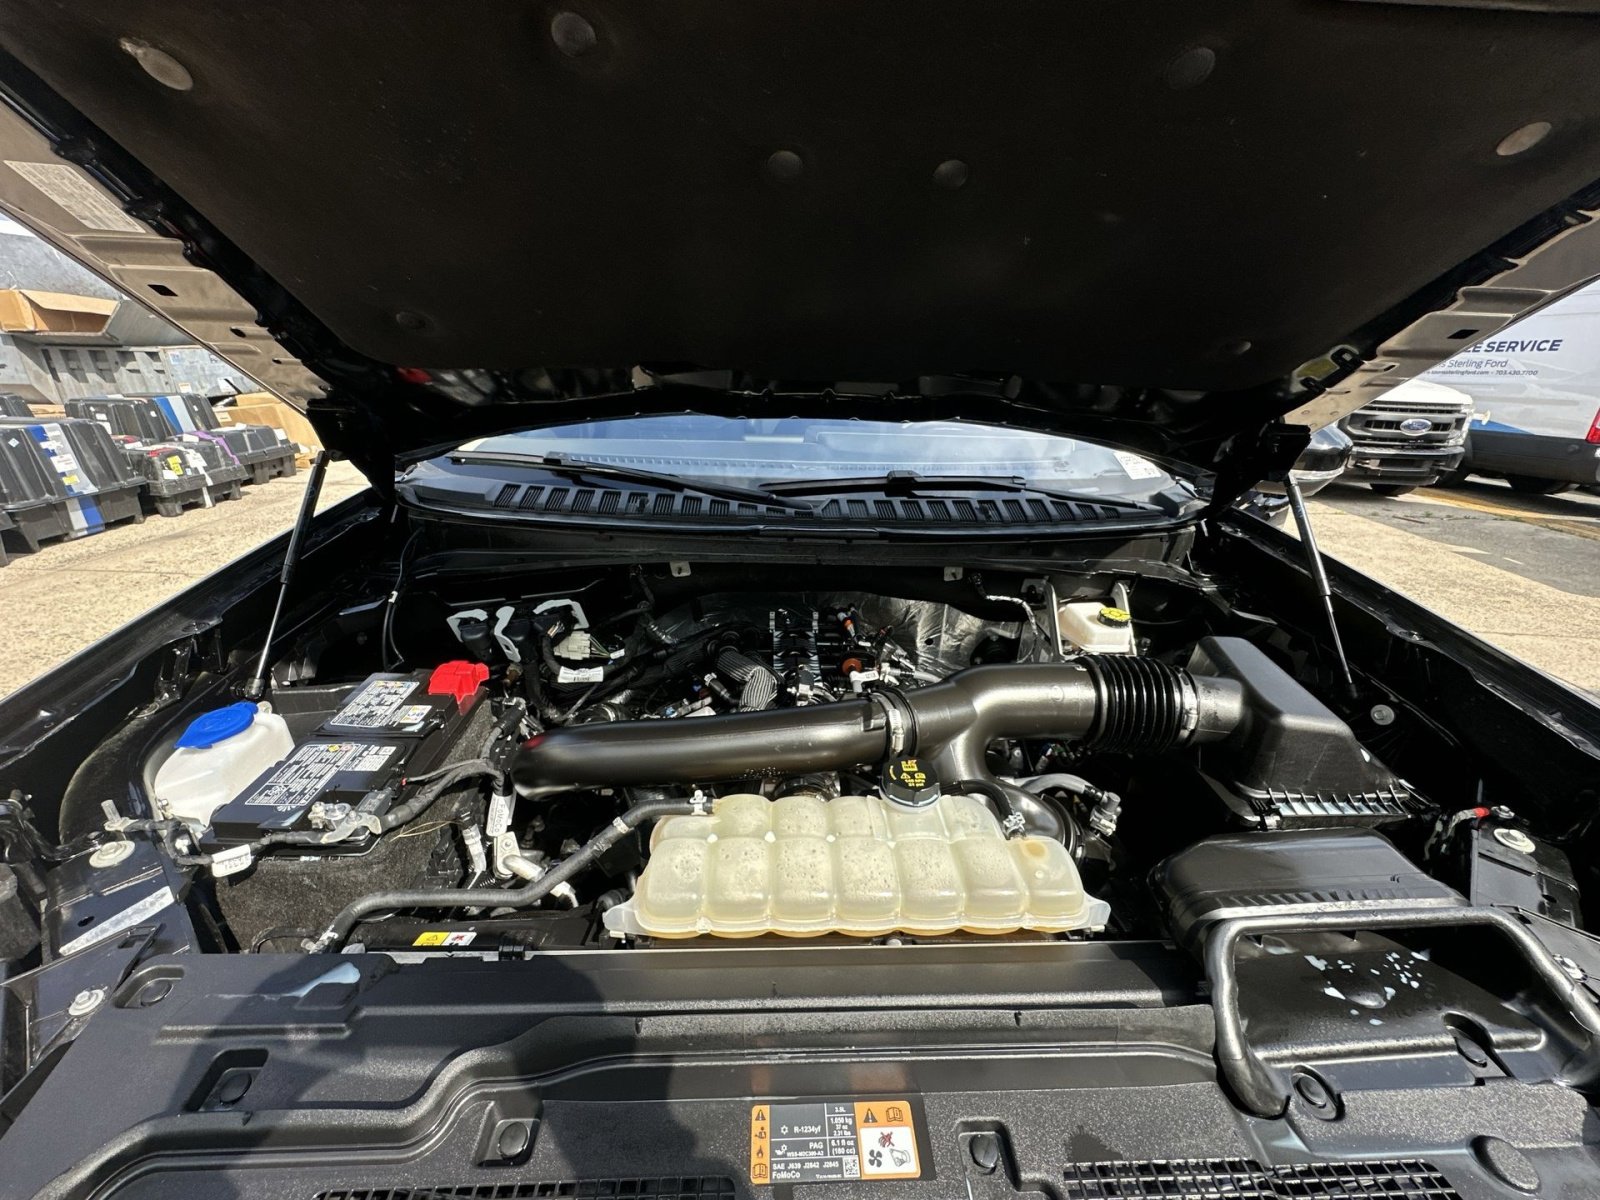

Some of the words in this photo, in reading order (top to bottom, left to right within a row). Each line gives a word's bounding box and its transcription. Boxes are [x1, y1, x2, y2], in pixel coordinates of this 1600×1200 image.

[1484, 339, 1563, 353] SERVICE
[1447, 359, 1483, 369] Sterling
[1484, 359, 1509, 368] Ford
[793, 1125, 821, 1135] R-1234yf
[809, 1142, 824, 1150] PAG
[772, 1171, 801, 1179] FoMoCo
